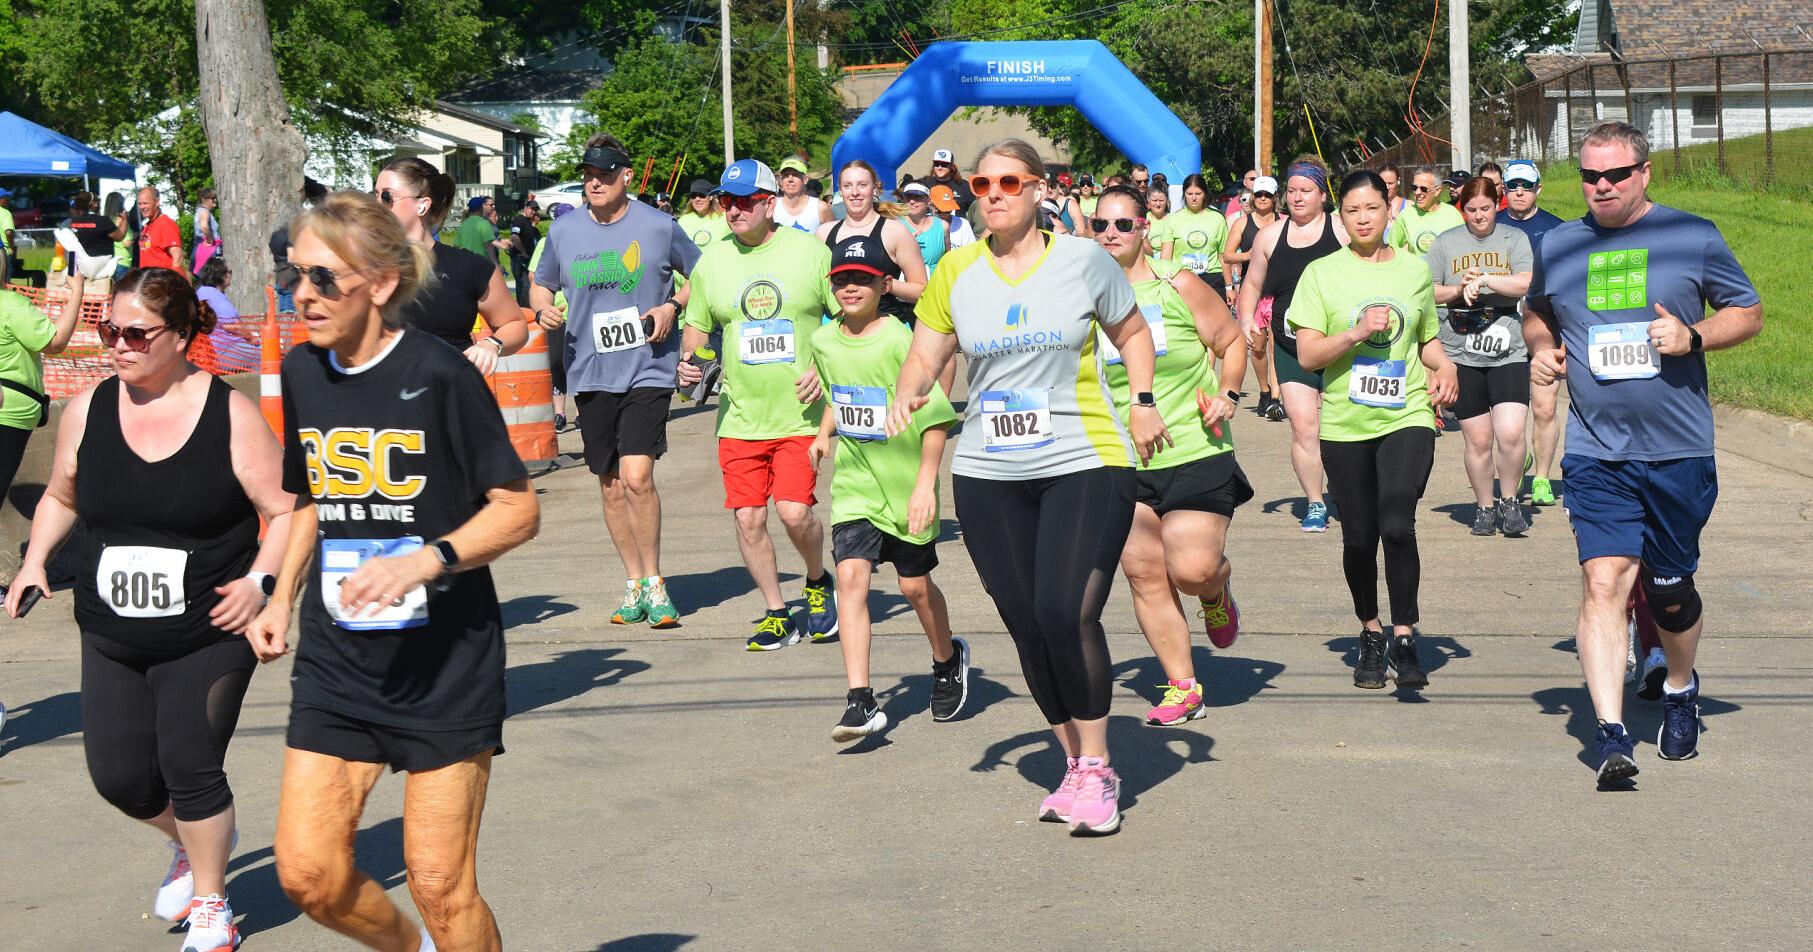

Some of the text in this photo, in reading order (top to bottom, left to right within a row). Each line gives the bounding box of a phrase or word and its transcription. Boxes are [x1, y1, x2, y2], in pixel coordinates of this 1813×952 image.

[987, 60, 1045, 74] FINISH
[1452, 252, 1513, 275] LOYOLA
[600, 322, 637, 349] 820
[748, 335, 786, 354] 1064
[974, 330, 1062, 353] MADISON
[1472, 334, 1503, 354] 804
[970, 344, 1070, 361] QUARTER MARATHON
[1600, 344, 1649, 367] 1089
[1360, 375, 1400, 397] 1033
[839, 405, 875, 427] 1073
[991, 412, 1040, 437] 1082
[350, 503, 367, 521] &
[369, 503, 415, 523] DIVE
[111, 570, 171, 609] 805
